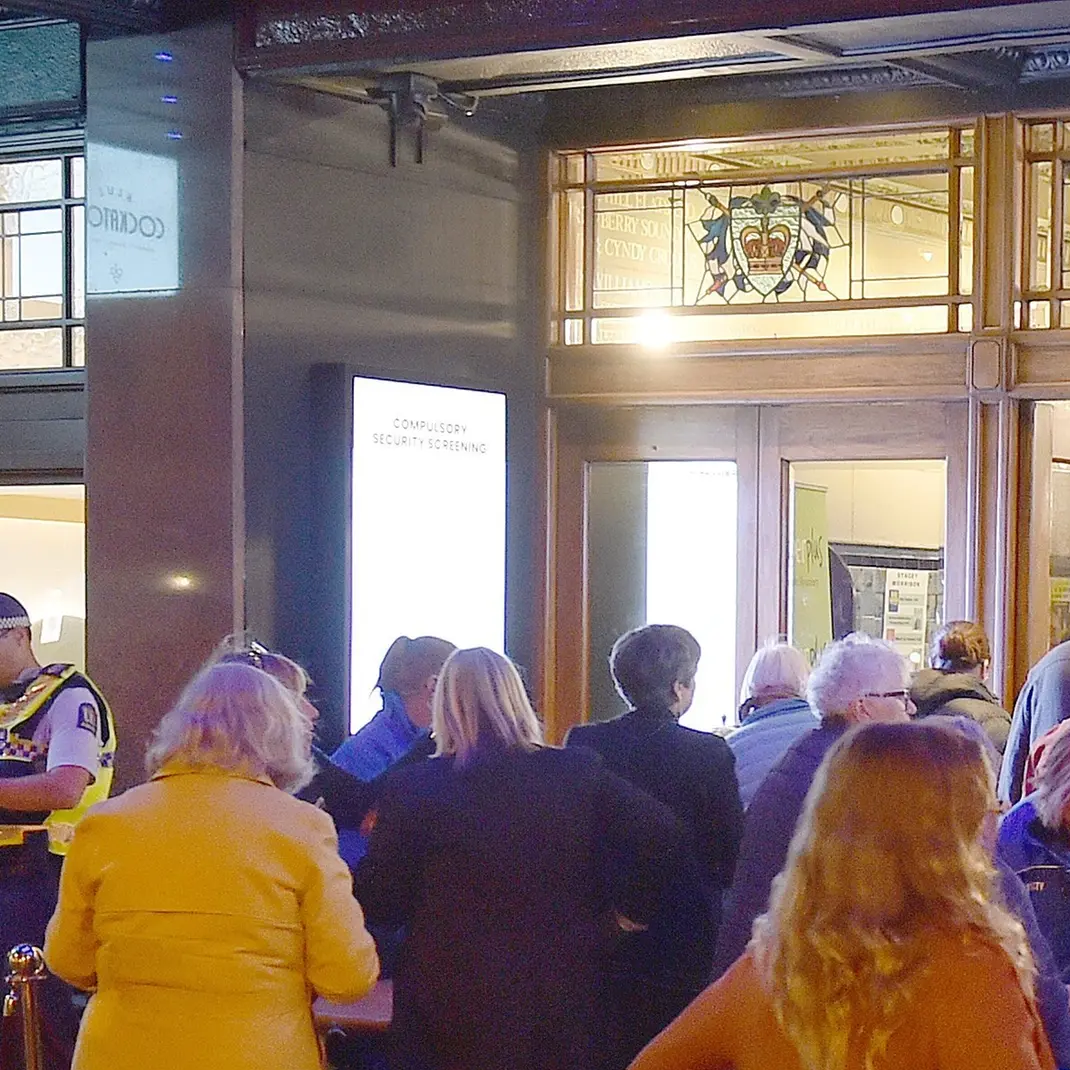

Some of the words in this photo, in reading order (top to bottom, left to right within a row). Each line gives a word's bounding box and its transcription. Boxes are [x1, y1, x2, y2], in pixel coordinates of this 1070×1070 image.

[393, 418, 467, 434] COMPULSORY
[372, 433, 424, 447] SECURITY
[428, 438, 487, 454] SCREENING
